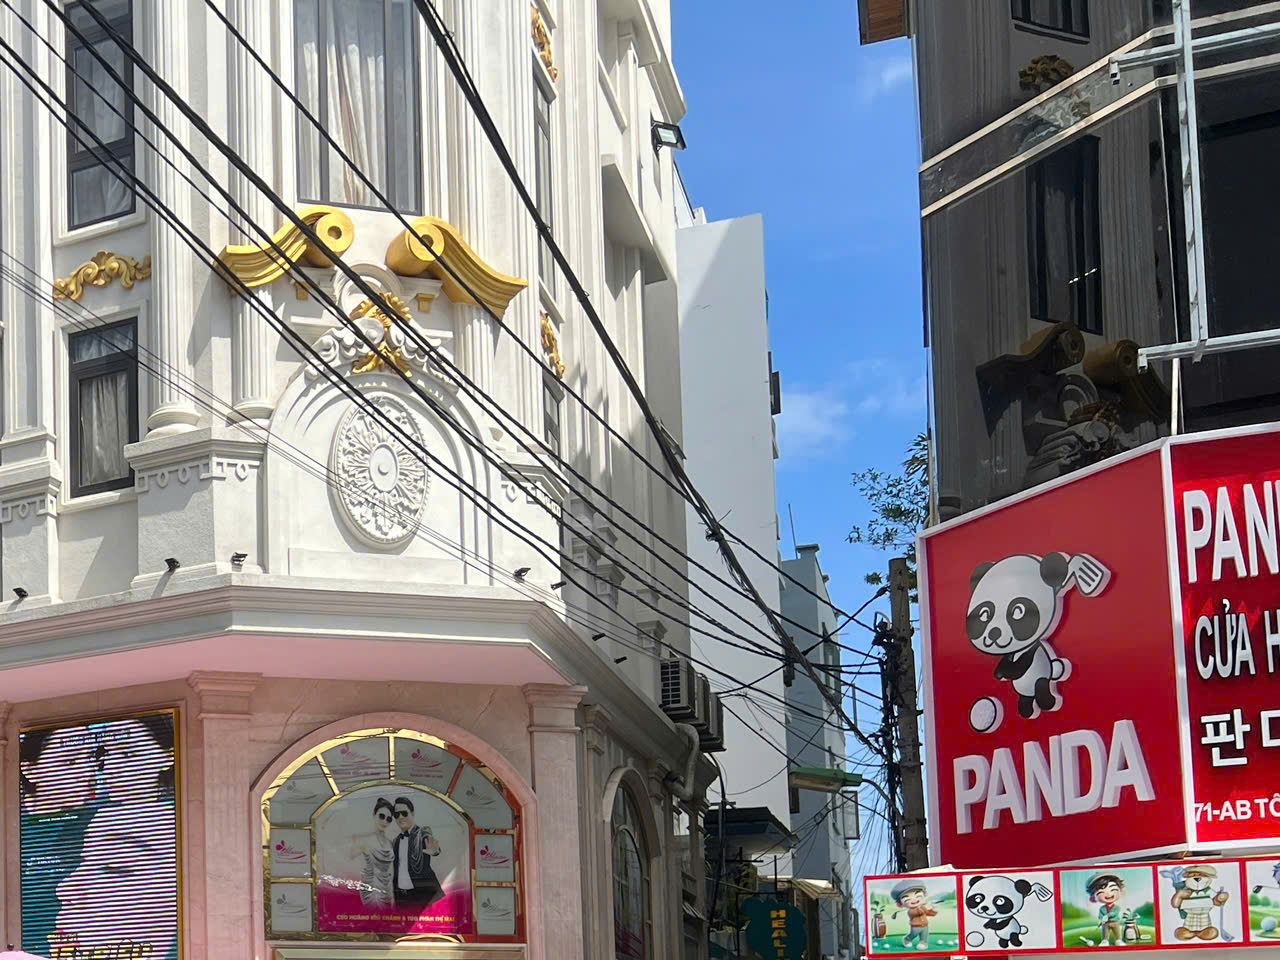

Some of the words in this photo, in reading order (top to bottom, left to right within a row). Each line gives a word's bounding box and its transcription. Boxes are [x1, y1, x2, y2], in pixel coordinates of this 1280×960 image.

[1183, 480, 1280, 584] PAN
[1194, 598, 1256, 680] CỬA
[953, 719, 1156, 834] PANDA
[1195, 799, 1252, 823] 71-AB
